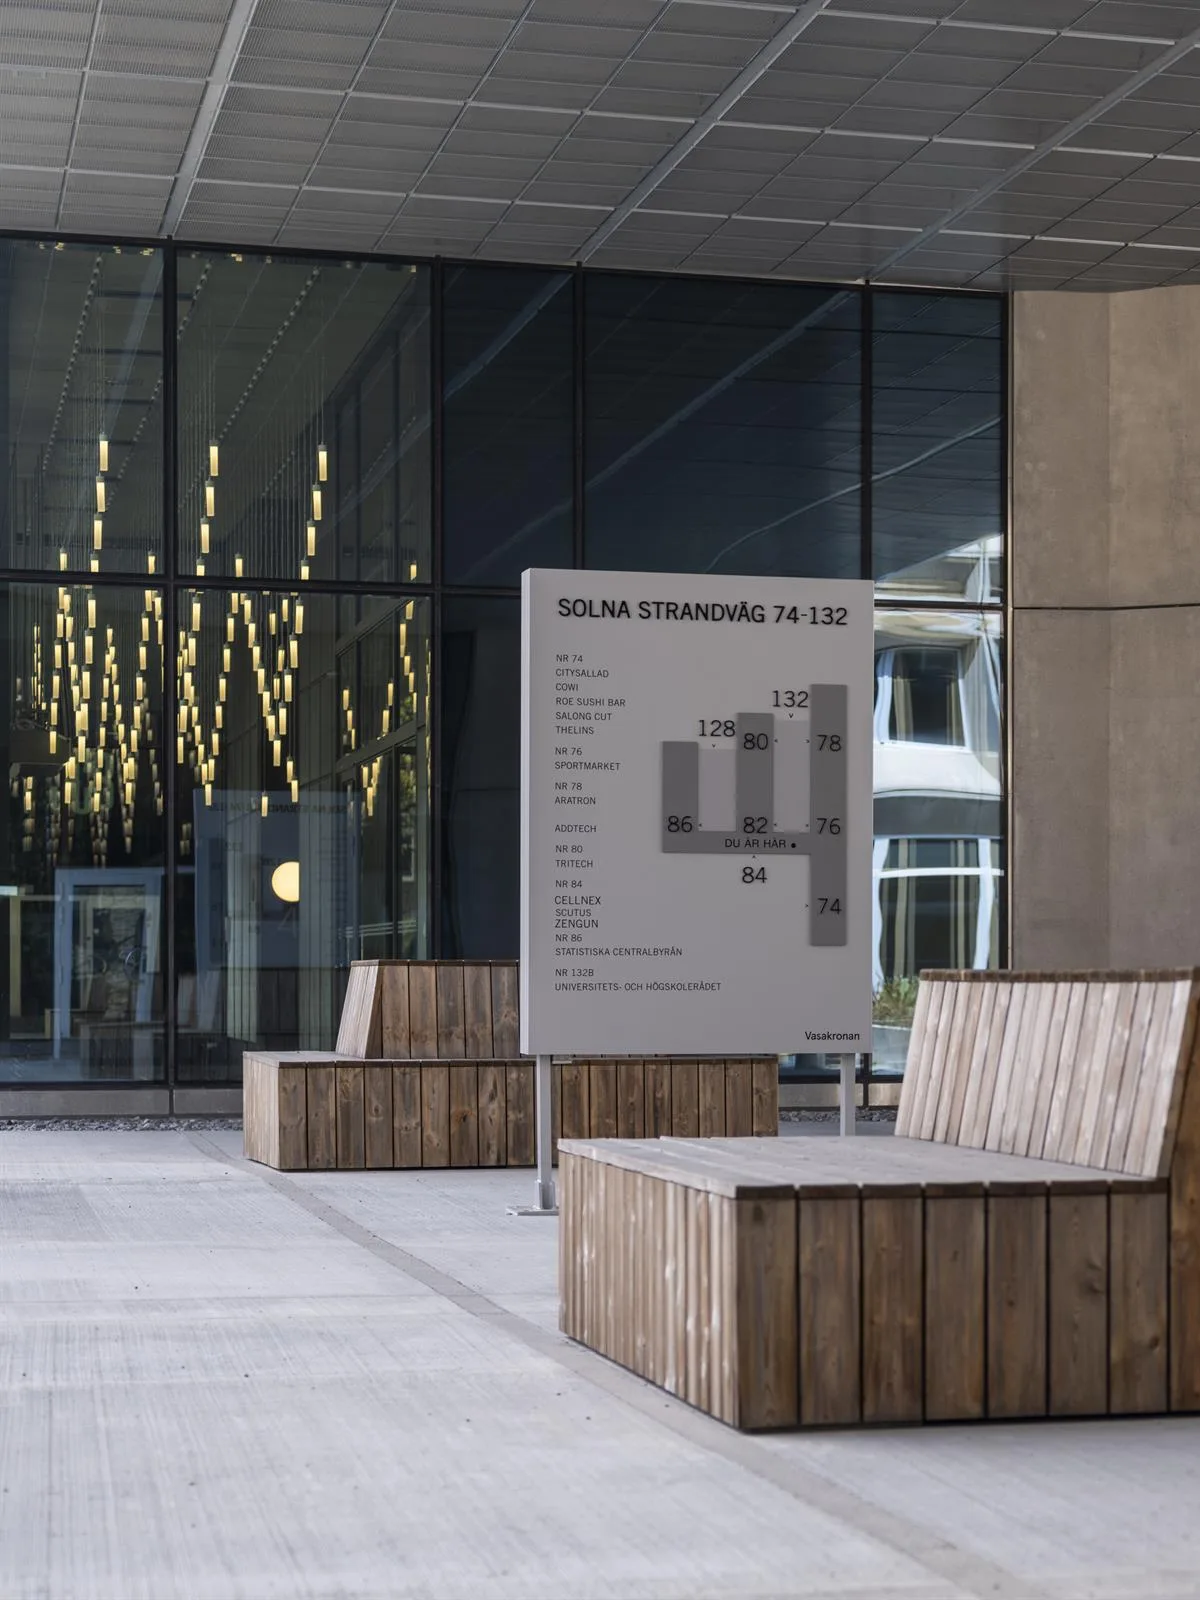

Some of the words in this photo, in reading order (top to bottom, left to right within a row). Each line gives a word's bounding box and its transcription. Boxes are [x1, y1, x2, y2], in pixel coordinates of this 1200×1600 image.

[558, 598, 631, 619] SOLNA
[638, 600, 766, 624] STRANDVÄG
[772, 605, 848, 626] 74-132
[555, 654, 569, 663] NR
[571, 654, 583, 664] 74
[555, 668, 610, 679] CITYSALLAD
[555, 682, 579, 692] COWI
[555, 696, 574, 706] ROE
[576, 697, 605, 707] SUSHI
[607, 698, 626, 707] BAR
[772, 689, 810, 709] 132
[555, 711, 592, 721] SALONG
[593, 712, 613, 721] CUT
[555, 725, 595, 736] THELINS
[698, 719, 737, 739] 128
[743, 732, 769, 751] 80
[816, 734, 843, 753] 78
[554, 746, 568, 756] NR
[570, 746, 583, 756] 76
[554, 760, 621, 771] SPORTMARKET
[554, 781, 568, 791] NR
[571, 782, 583, 791] 78
[554, 795, 596, 805] ARATRON
[554, 824, 597, 833] ADDTECH
[667, 815, 693, 833] 86
[742, 816, 768, 835] 82
[816, 817, 841, 836] 76
[555, 844, 569, 854] NR
[570, 844, 584, 854] 80
[724, 838, 741, 849] DU
[555, 859, 594, 869] TRITECH
[741, 866, 768, 884] 84
[555, 879, 569, 888] NR
[570, 879, 583, 889] 84
[554, 895, 601, 906] CELLNEX
[817, 897, 843, 915] 74
[554, 908, 592, 918] SCUTUS
[554, 918, 599, 929] ZENGUN
[555, 933, 569, 942] NR
[570, 933, 583, 943] 86
[555, 947, 611, 957] STATISTISKA
[612, 945, 683, 957] CENTRALBYRÅN
[555, 968, 569, 977] NR
[571, 968, 594, 977] 132B
[554, 982, 622, 992] UNIVERSITETS-
[623, 982, 643, 991] OCH
[645, 980, 722, 992] HÖGSKOLERÅDET
[804, 1031, 860, 1041] Vasakronan
